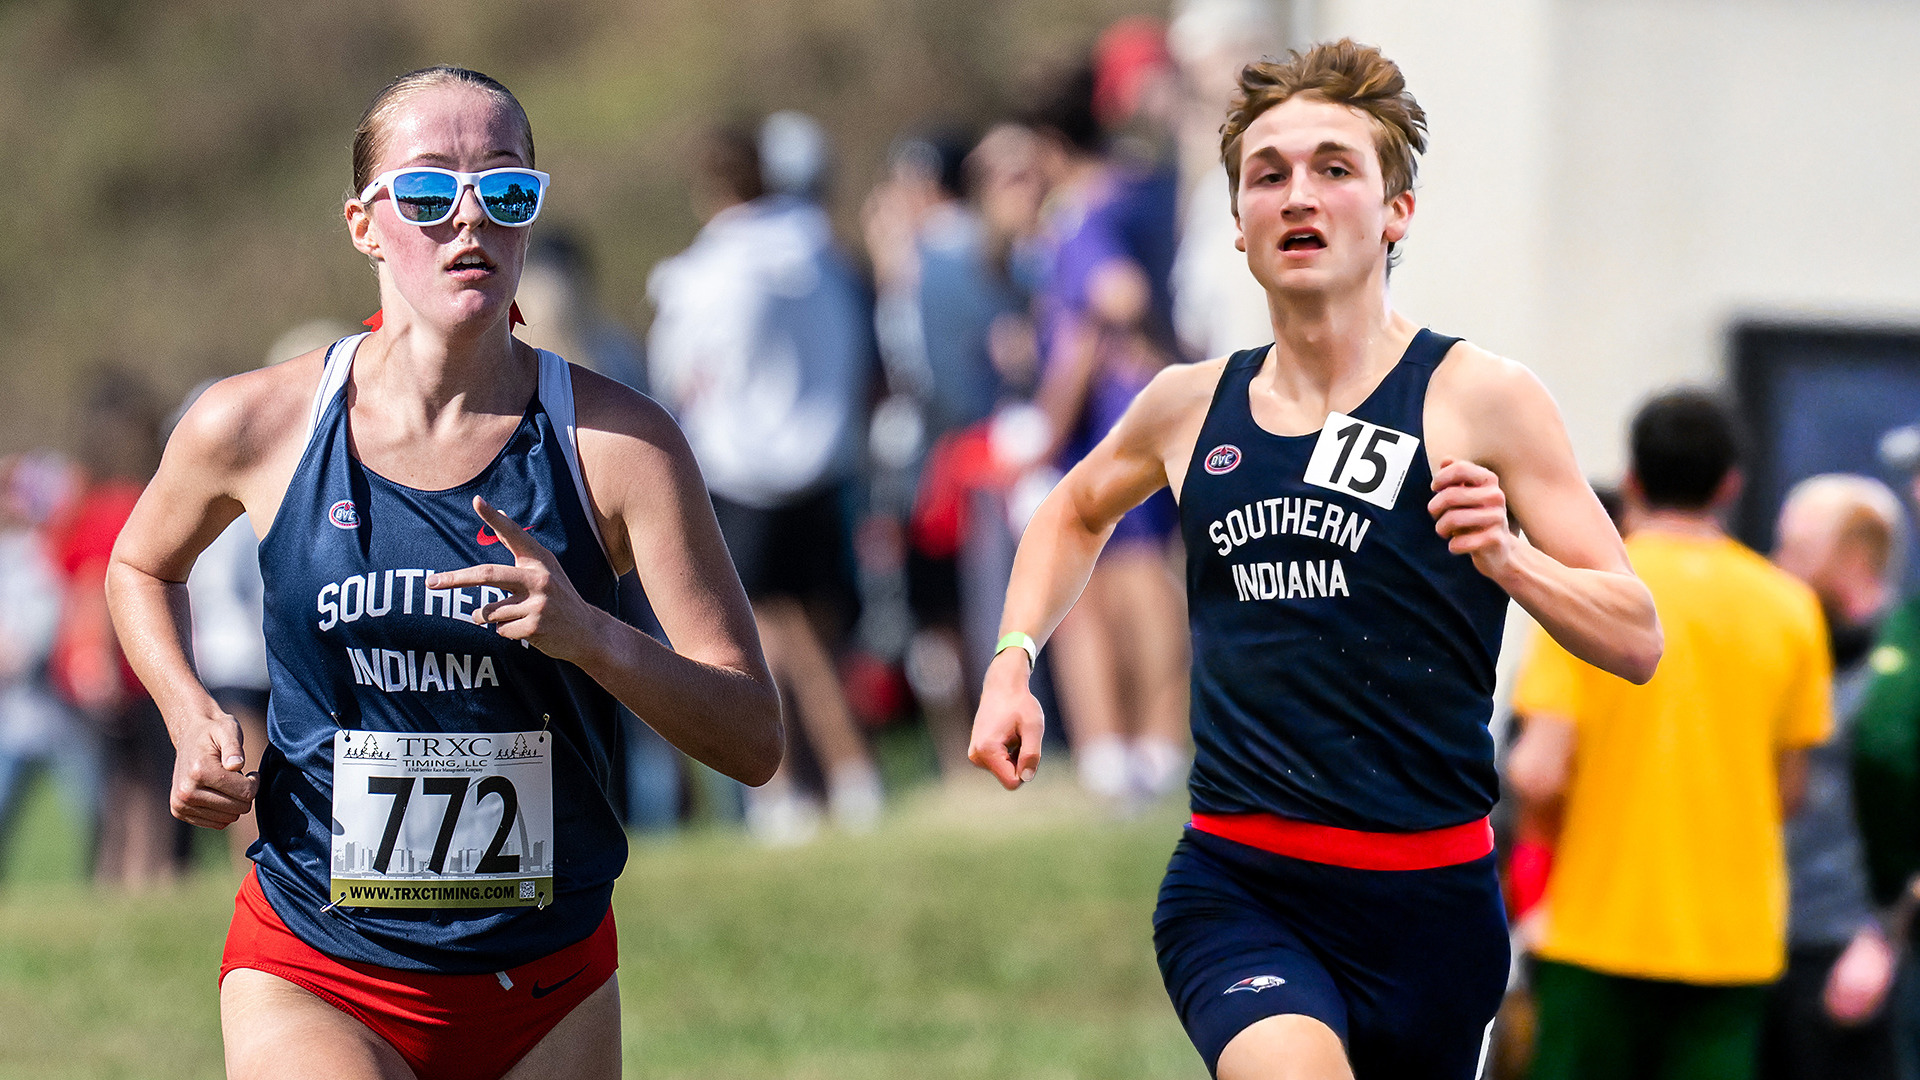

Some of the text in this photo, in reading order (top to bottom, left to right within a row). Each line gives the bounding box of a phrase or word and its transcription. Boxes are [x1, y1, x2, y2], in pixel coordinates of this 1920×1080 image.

[1328, 422, 1400, 494] 15
[1208, 497, 1371, 556] SOUTHERN
[1231, 559, 1350, 601] INDIANA
[317, 568, 529, 649] SOUTHE
[346, 646, 499, 692] INDIANA
[396, 737, 492, 757] TRXC
[402, 759, 488, 768] TIMING, LLC
[368, 776, 521, 875] 772
[350, 886, 515, 900] WWW.TRXCTIMING.COM
